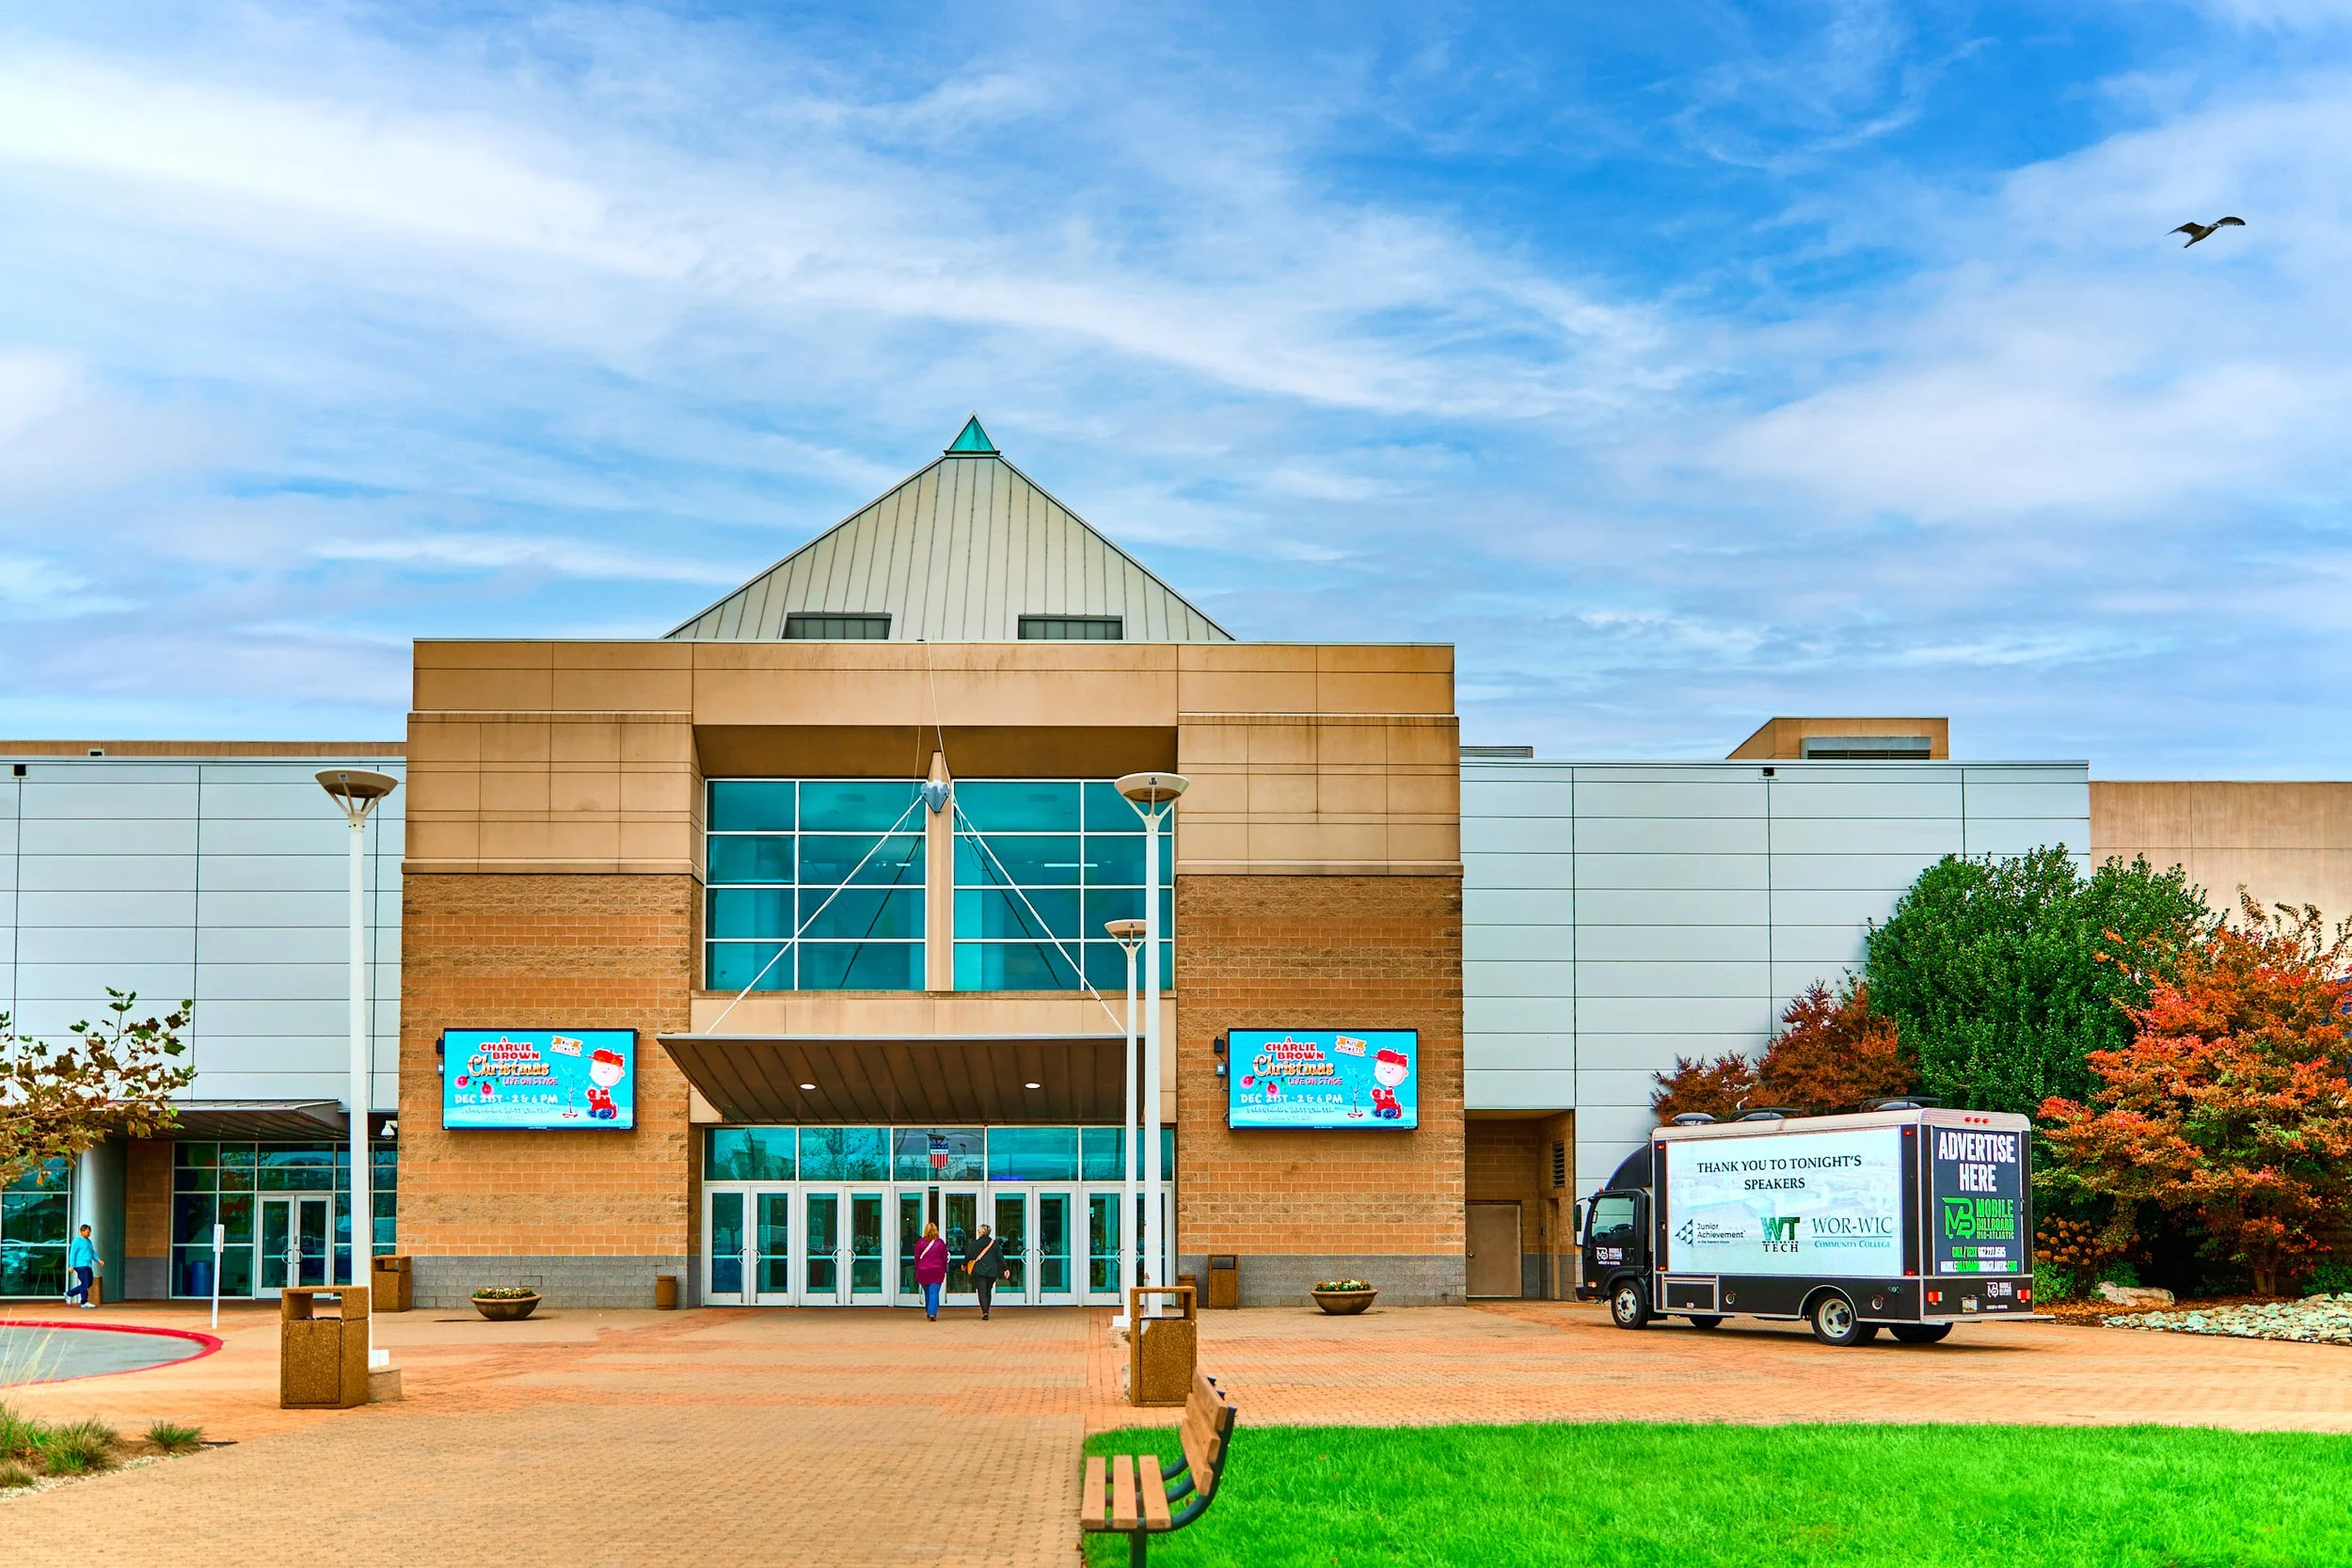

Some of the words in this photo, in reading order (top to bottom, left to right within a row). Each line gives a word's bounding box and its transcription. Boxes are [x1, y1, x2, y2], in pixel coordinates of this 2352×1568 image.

[481, 1043, 532, 1052] CHARLIE
[1264, 1043, 1316, 1052] CHARLIE
[492, 1052, 540, 1060] BROWN
[1277, 1052, 1325, 1060] BROWN
[468, 1053, 550, 1077] Christmas
[1252, 1053, 1335, 1077] Christmas
[503, 1078, 519, 1086] LIVE
[533, 1077, 559, 1085] STAGE
[1319, 1077, 1343, 1085] STAGE
[454, 1094, 477, 1104] DEC
[480, 1094, 503, 1103] 21ST
[512, 1094, 519, 1103] 2
[532, 1094, 538, 1103] 6
[540, 1094, 559, 1104] PM
[1240, 1094, 1263, 1103] DEC
[1265, 1094, 1289, 1103] 21ST
[1296, 1094, 1305, 1103] 2
[1317, 1094, 1323, 1103] 6
[1325, 1094, 1343, 1103] PM
[1938, 1132, 2016, 1164] ADVERTISE
[1697, 1161, 1739, 1173] THANK
[1741, 1160, 1767, 1171] YOU
[1770, 1159, 1787, 1170] TO
[1789, 1154, 1862, 1169] TONIGHT'S
[1959, 1163, 1997, 1193] HERE
[1744, 1177, 1805, 1190] SPEAKERS
[1976, 1198, 2014, 1218] MOBILE
[1696, 1222, 1719, 1230] Junior
[1760, 1216, 1801, 1241] WT
[1812, 1216, 1893, 1234] WOR-WIC
[1976, 1217, 2014, 1231] BILLBOARD
[1697, 1230, 1744, 1239] Achievement
[1762, 1243, 1799, 1252] TECH
